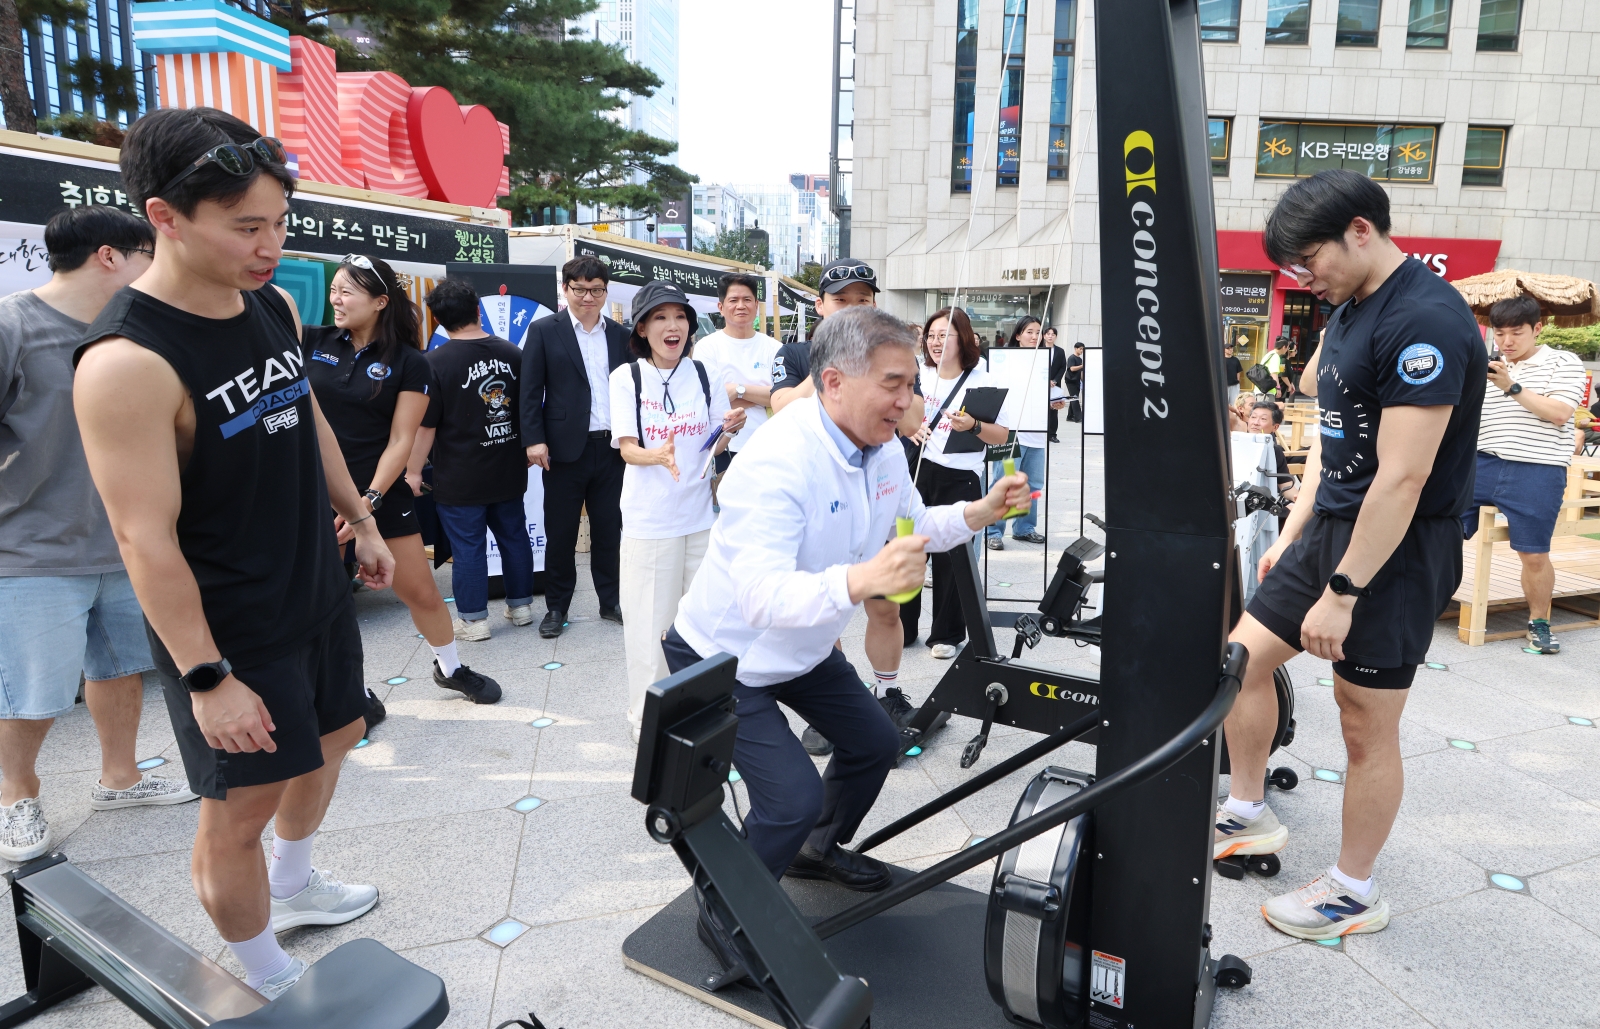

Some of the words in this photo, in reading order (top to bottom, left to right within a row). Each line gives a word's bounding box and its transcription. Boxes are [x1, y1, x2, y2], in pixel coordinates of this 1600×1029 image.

[1301, 142, 1329, 159] KB
[1332, 142, 1389, 161] 국민은행
[59, 180, 144, 218] 취향
[331, 217, 365, 241] 주스
[372, 225, 427, 252] 만들기
[1402, 252, 1449, 278] YS
[652, 265, 672, 281] 오늘의
[673, 269, 700, 289] 컨디션을
[1131, 201, 1165, 387] concept
[1235, 286, 1267, 297] 국민은행
[1404, 356, 1434, 372] F45
[252, 383, 303, 420] COACH
[1143, 397, 1169, 419] 2
[263, 406, 299, 434] F45
[485, 421, 512, 438] VANS
[645, 424, 669, 440] 강남
[673, 421, 708, 437] 대전환!
[1354, 403, 1369, 439] FIVE
[1355, 666, 1379, 674] LESTE
[1060, 689, 1100, 706] con
